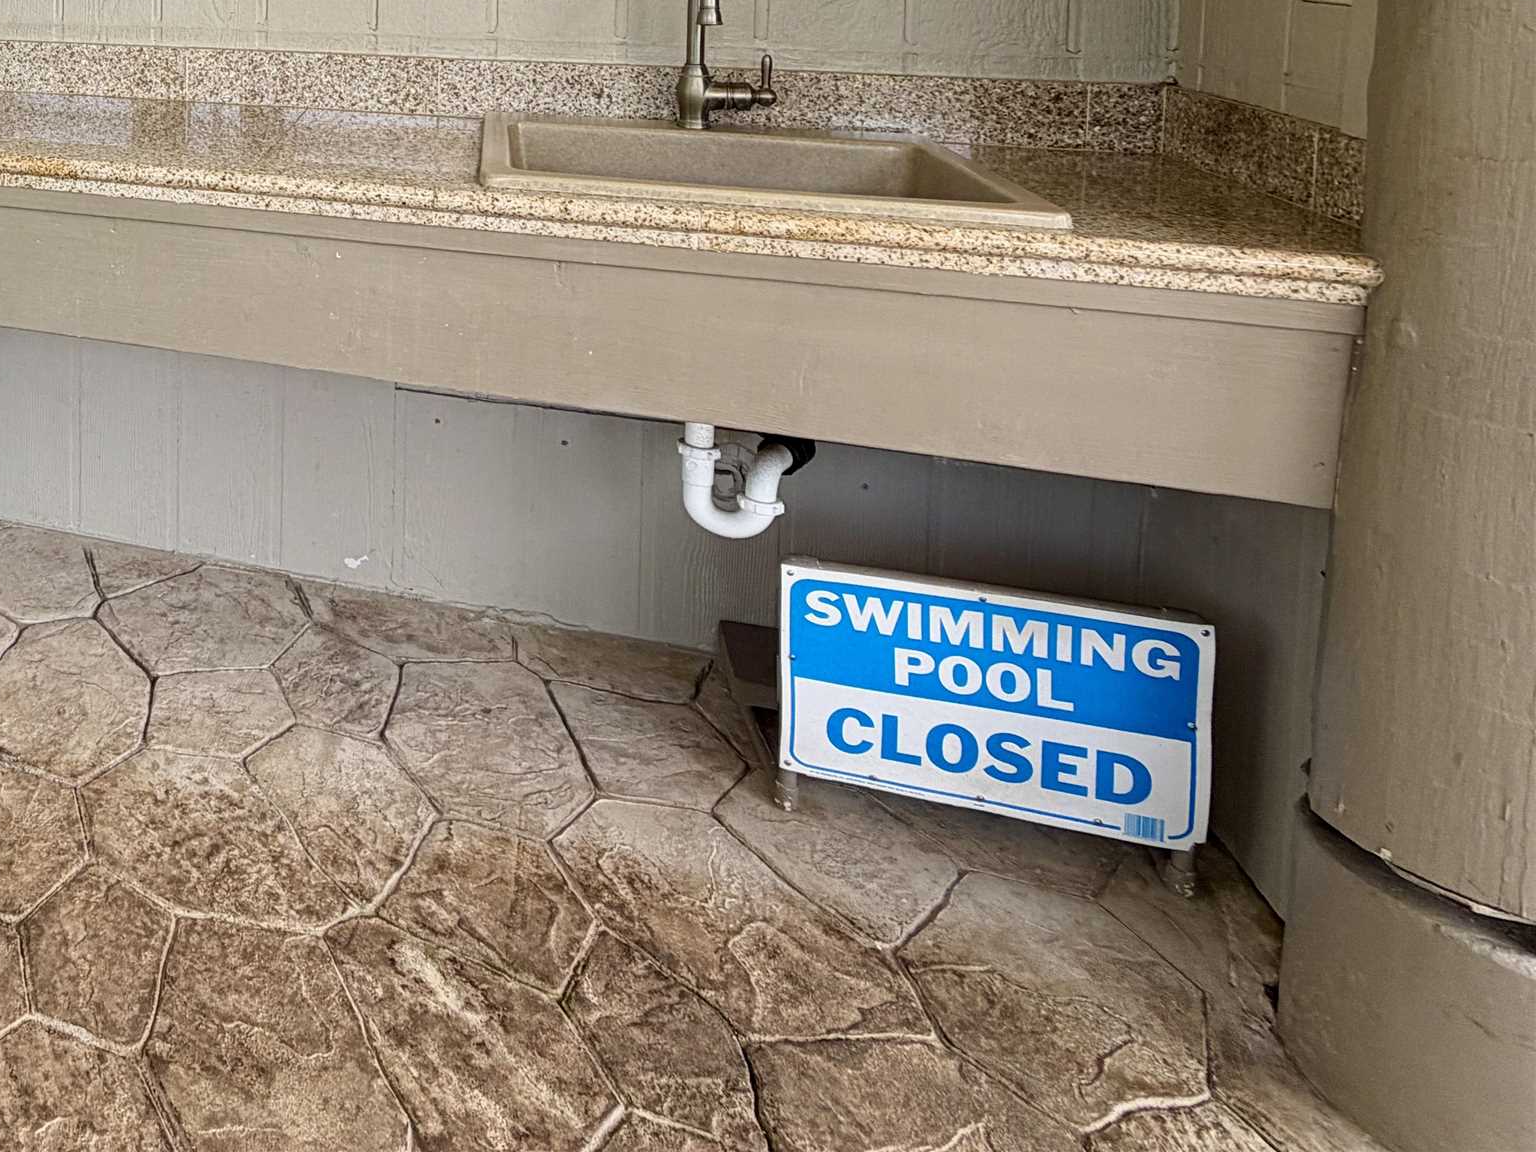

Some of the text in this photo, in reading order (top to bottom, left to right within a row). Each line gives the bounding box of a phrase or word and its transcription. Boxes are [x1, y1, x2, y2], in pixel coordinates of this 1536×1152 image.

[803, 589, 1182, 681] SWIMMING
[893, 647, 1076, 712] POOL
[826, 707, 1153, 806] CLOSED
